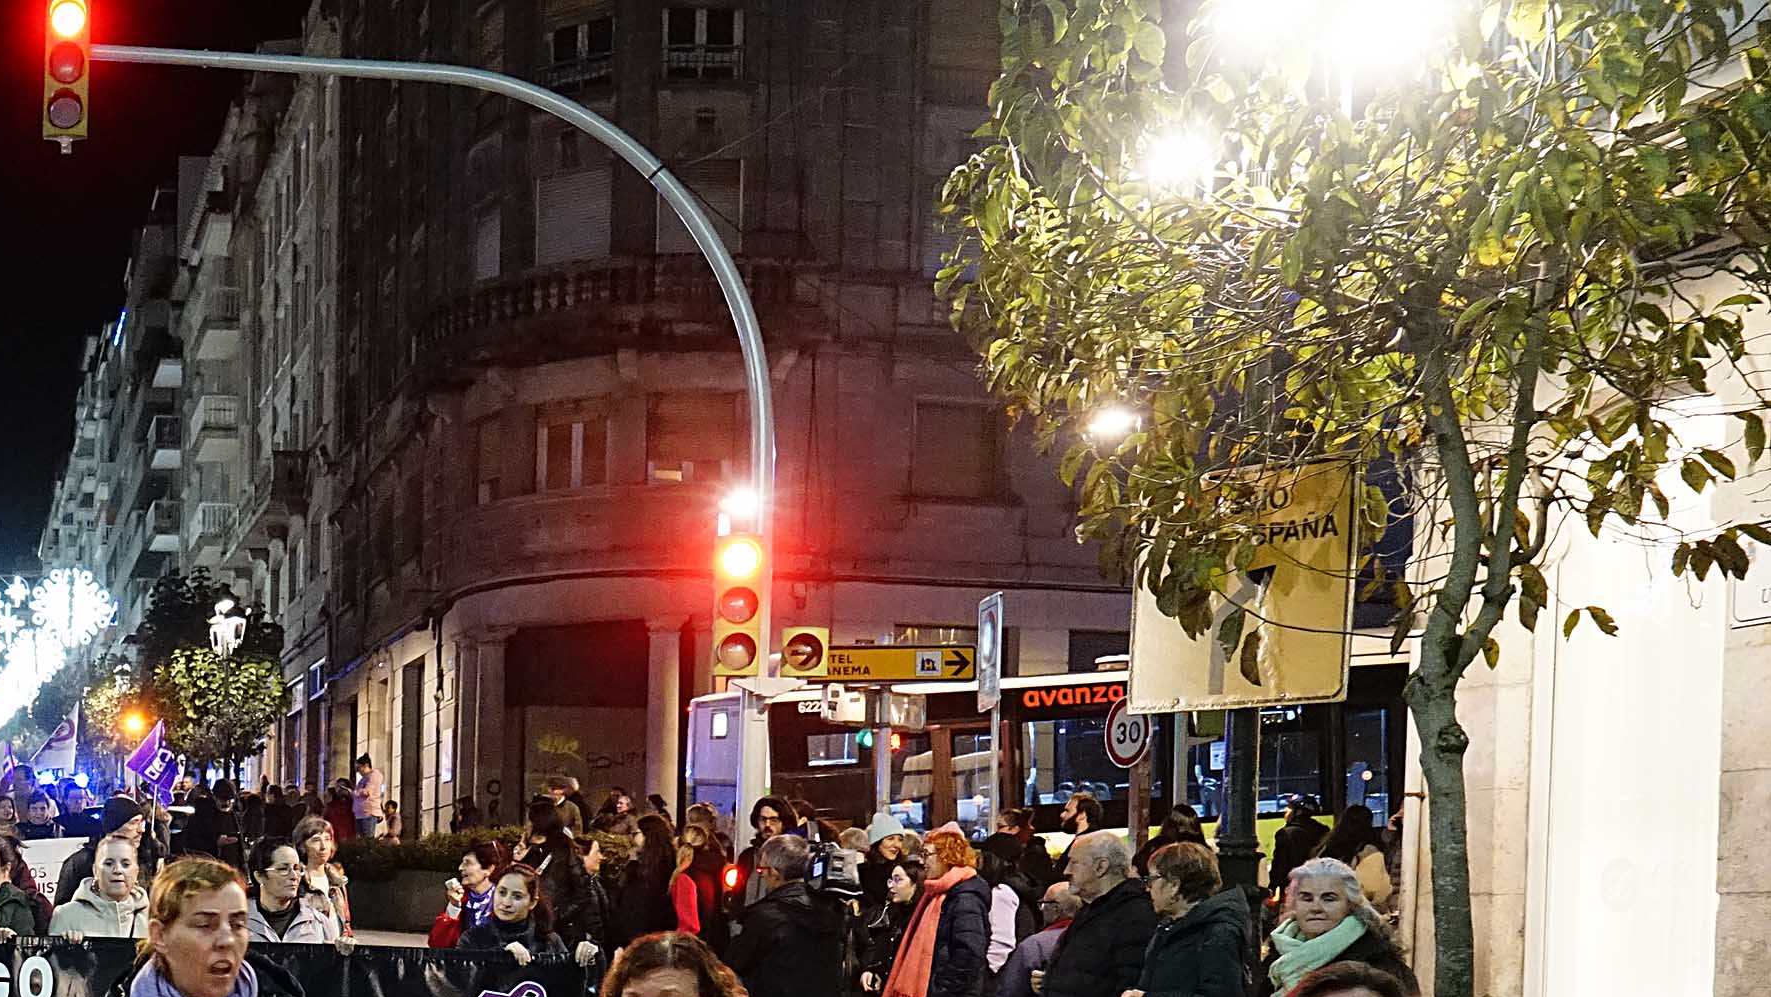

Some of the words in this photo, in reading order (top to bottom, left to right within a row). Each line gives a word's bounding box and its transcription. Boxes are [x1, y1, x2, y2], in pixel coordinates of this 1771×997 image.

[1251, 511, 1339, 546] SPAÑA
[827, 654, 853, 664] TEL
[1023, 685, 1125, 708] avanza
[1116, 720, 1141, 745] 30
